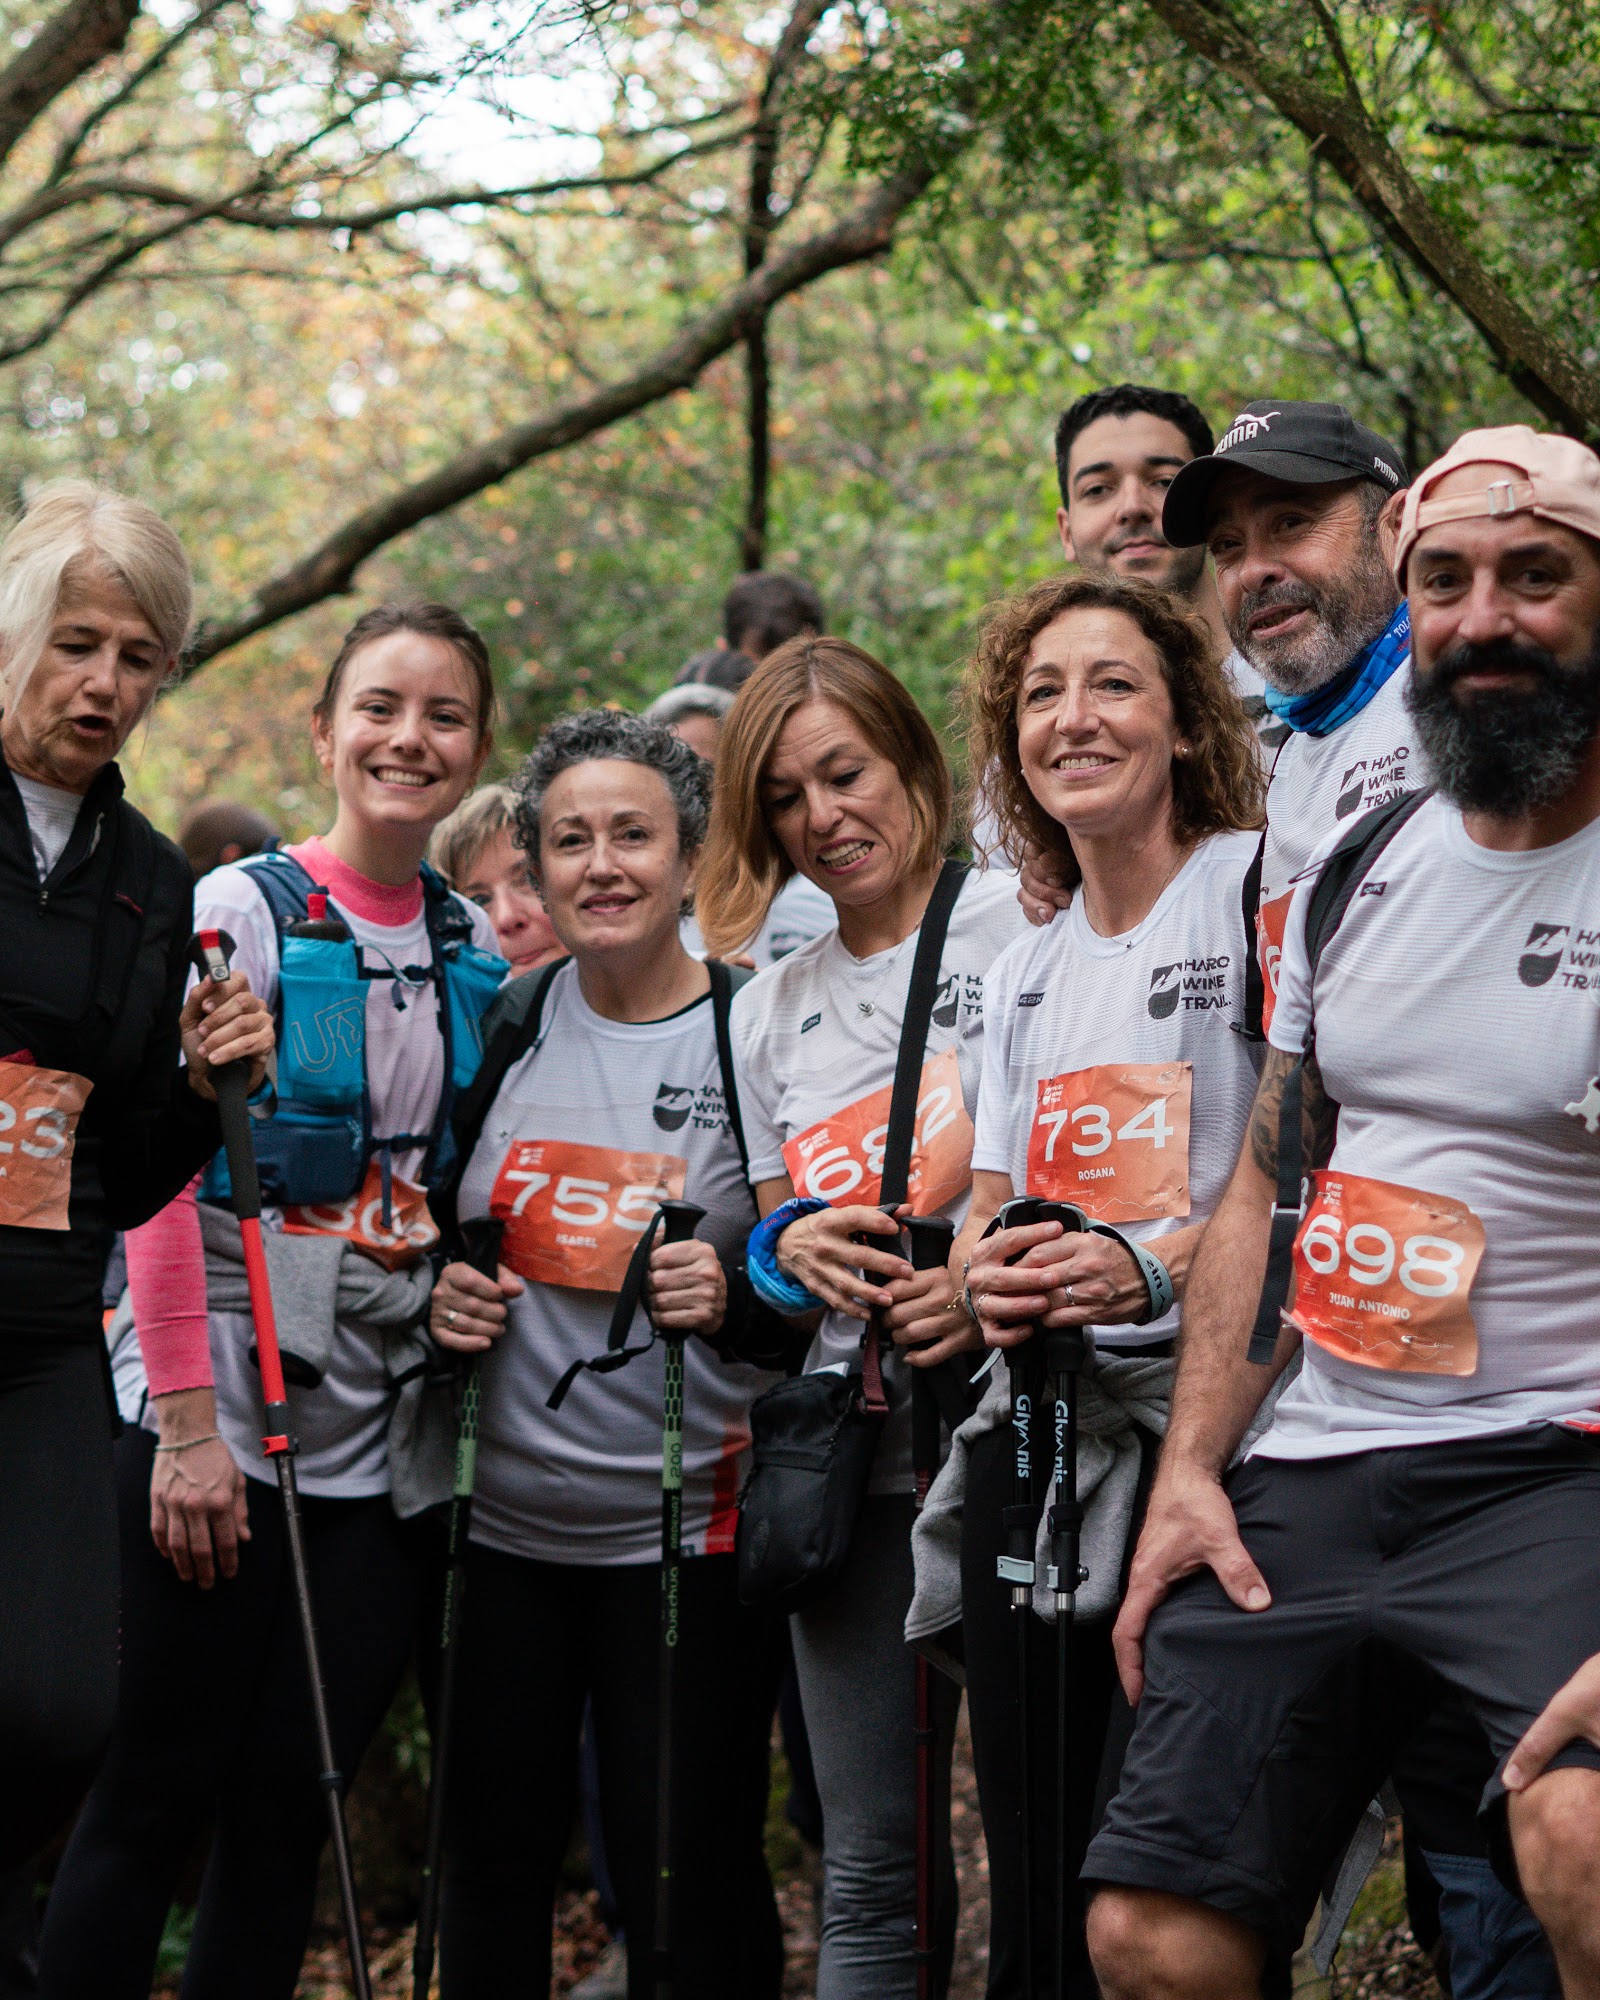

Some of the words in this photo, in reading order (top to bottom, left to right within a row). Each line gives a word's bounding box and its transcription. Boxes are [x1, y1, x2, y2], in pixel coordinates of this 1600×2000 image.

[1184, 956, 1230, 972] HARO
[1182, 974, 1225, 990] WINE
[1181, 994, 1232, 1010] TRAIL
[805, 1085, 957, 1200] 682
[1038, 1098, 1174, 1162] 734
[1077, 1166, 1116, 1181] ROSANA
[505, 1169, 669, 1231] 755
[556, 1233, 598, 1249] ISABEL
[1302, 1213, 1466, 1297] 698
[1329, 1291, 1355, 1309] JUAN
[1358, 1299, 1411, 1320] ANTONIO
[669, 1441, 682, 1479] 200
[665, 1566, 679, 1648] Quechua
